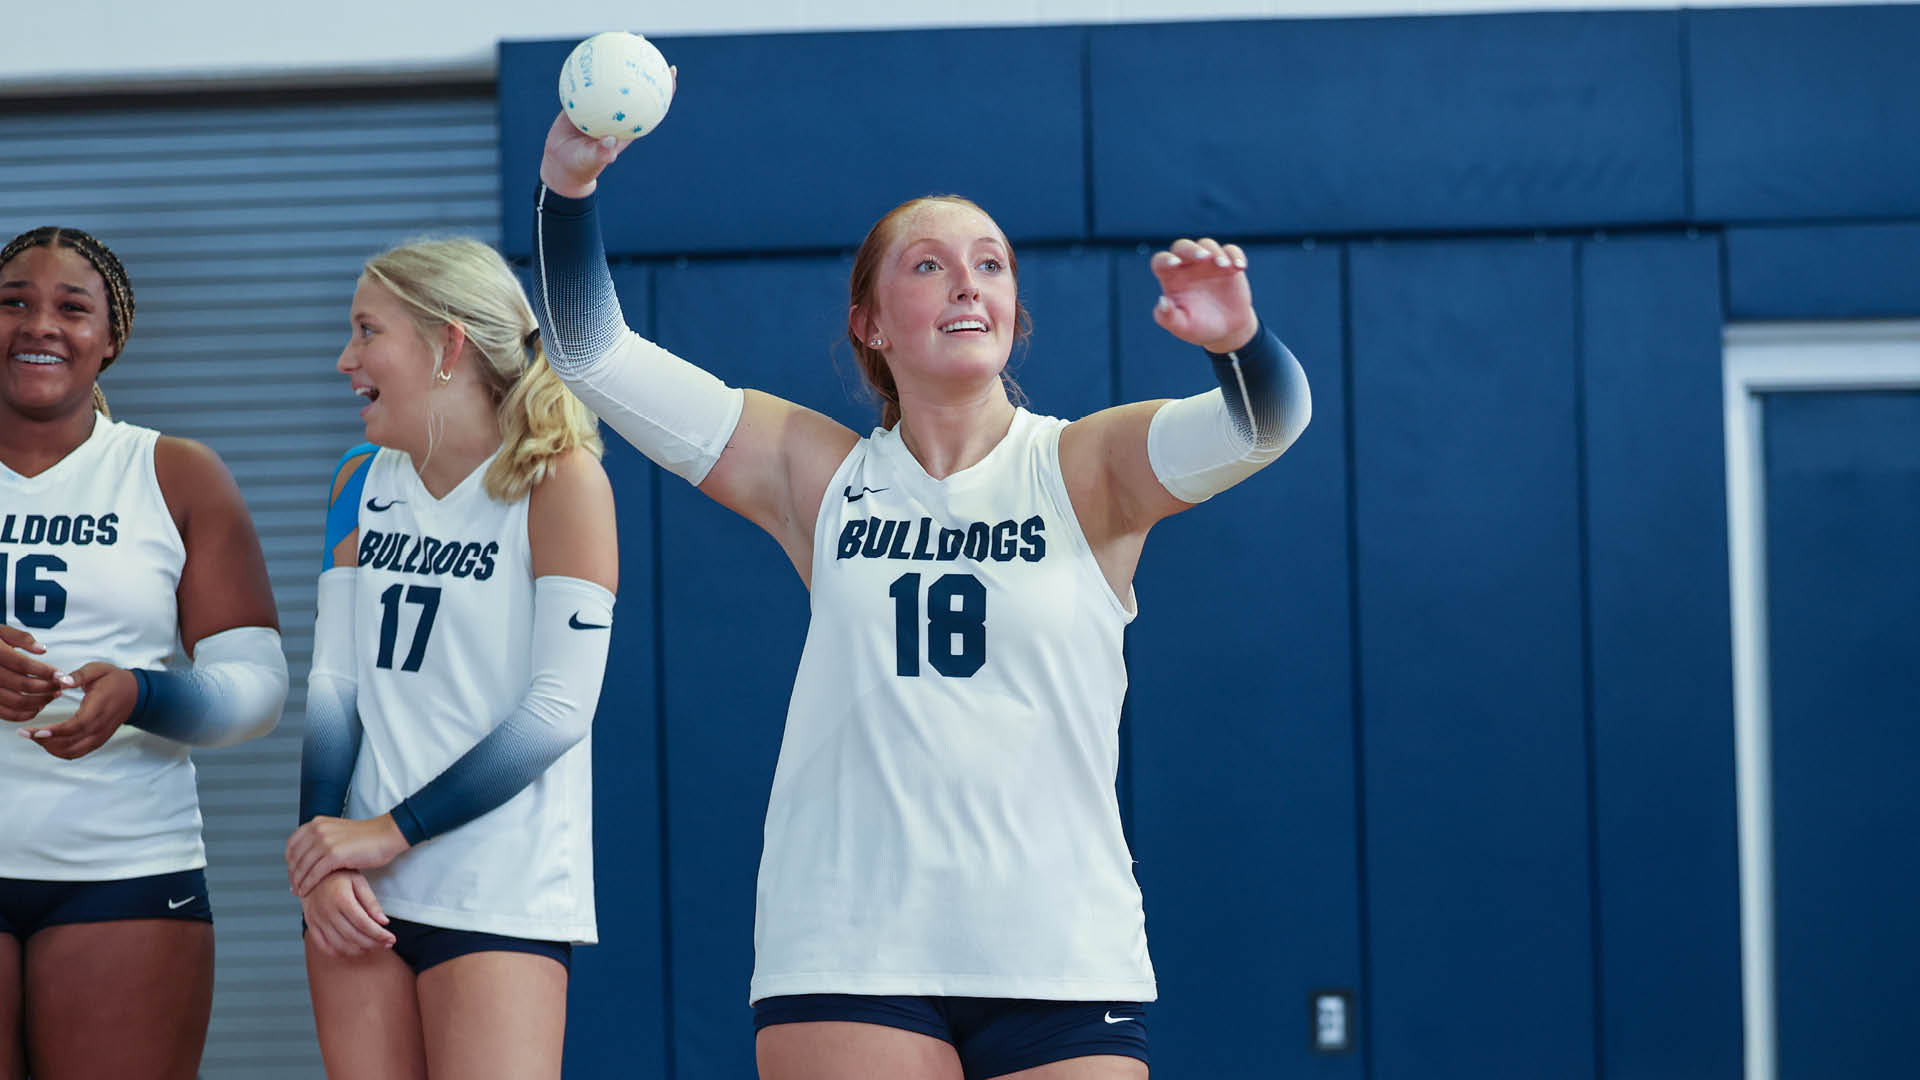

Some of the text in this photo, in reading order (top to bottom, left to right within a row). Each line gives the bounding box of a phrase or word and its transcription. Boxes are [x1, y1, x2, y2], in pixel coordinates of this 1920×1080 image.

[357, 529, 499, 581] BULLDOGS
[836, 515, 1046, 562] BULLDOGS
[376, 583, 442, 672] 17
[889, 572, 987, 678] 18
